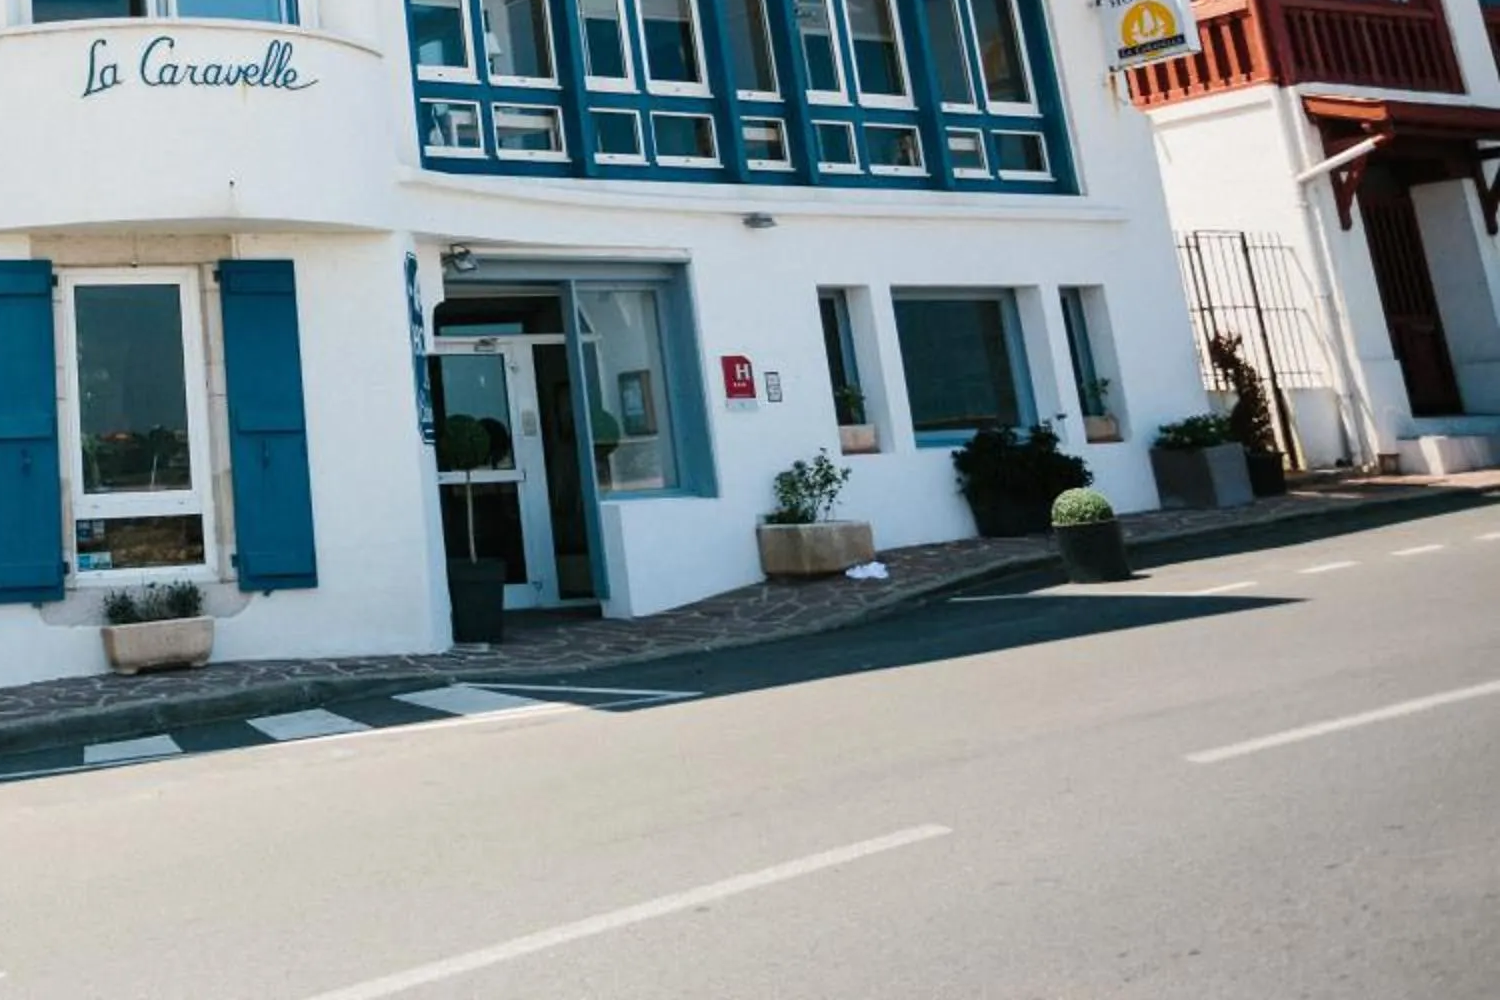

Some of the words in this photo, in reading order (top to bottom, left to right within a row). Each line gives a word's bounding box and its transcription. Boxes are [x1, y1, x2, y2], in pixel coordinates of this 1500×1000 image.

[81, 38, 125, 99] La
[140, 36, 319, 90] Caravelle
[735, 363, 750, 381] H
